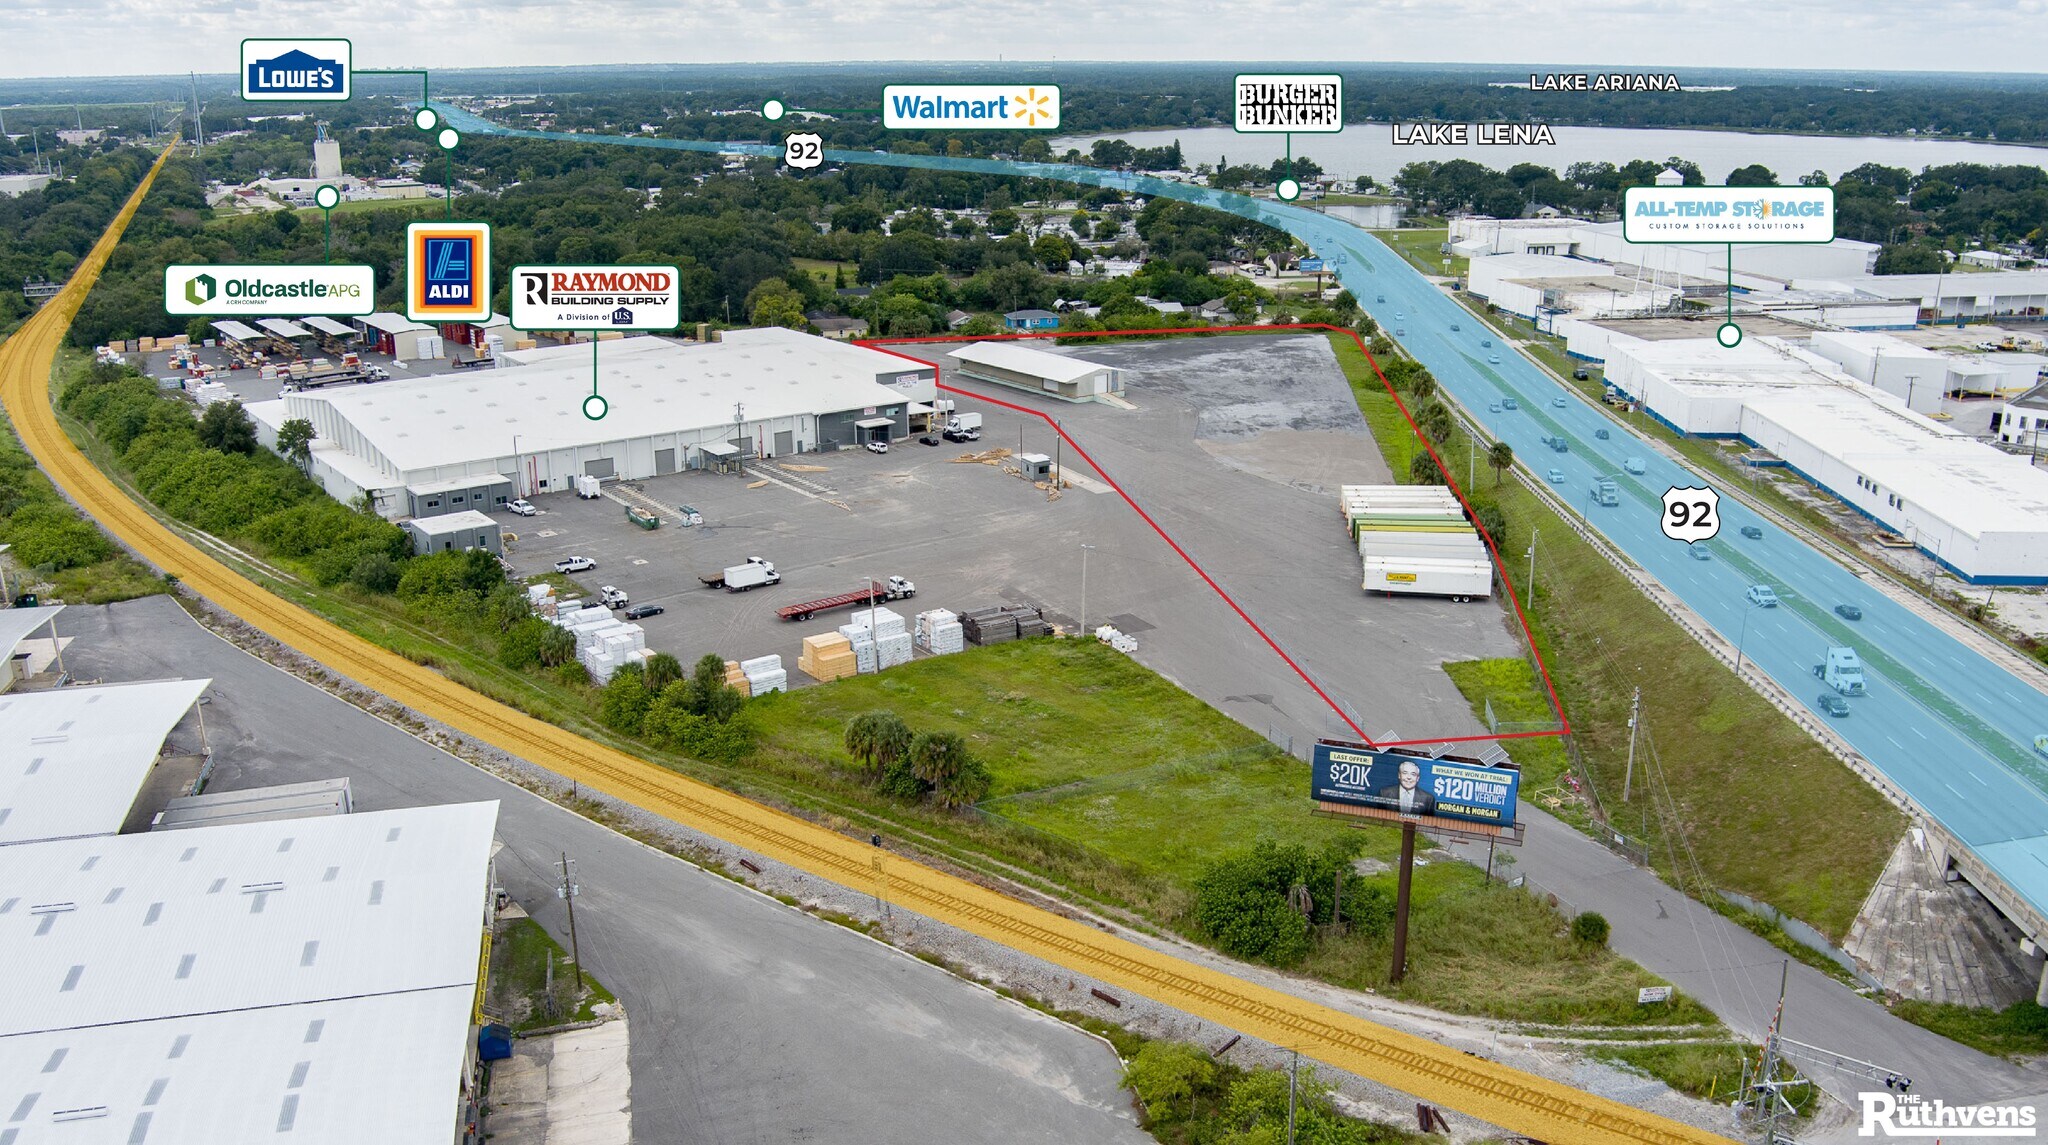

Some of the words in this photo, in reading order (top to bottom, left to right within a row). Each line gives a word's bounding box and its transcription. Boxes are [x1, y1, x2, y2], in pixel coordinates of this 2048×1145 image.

[1329, 763, 1372, 787] $20K
[1434, 777, 1473, 801] $120
[1474, 782, 1507, 796] MILLION
[1474, 792, 1506, 805] VERDICT
[1438, 803, 1464, 814] MORGAN
[1465, 806, 1471, 815] &
[1471, 807, 1498, 818] MORGAN
